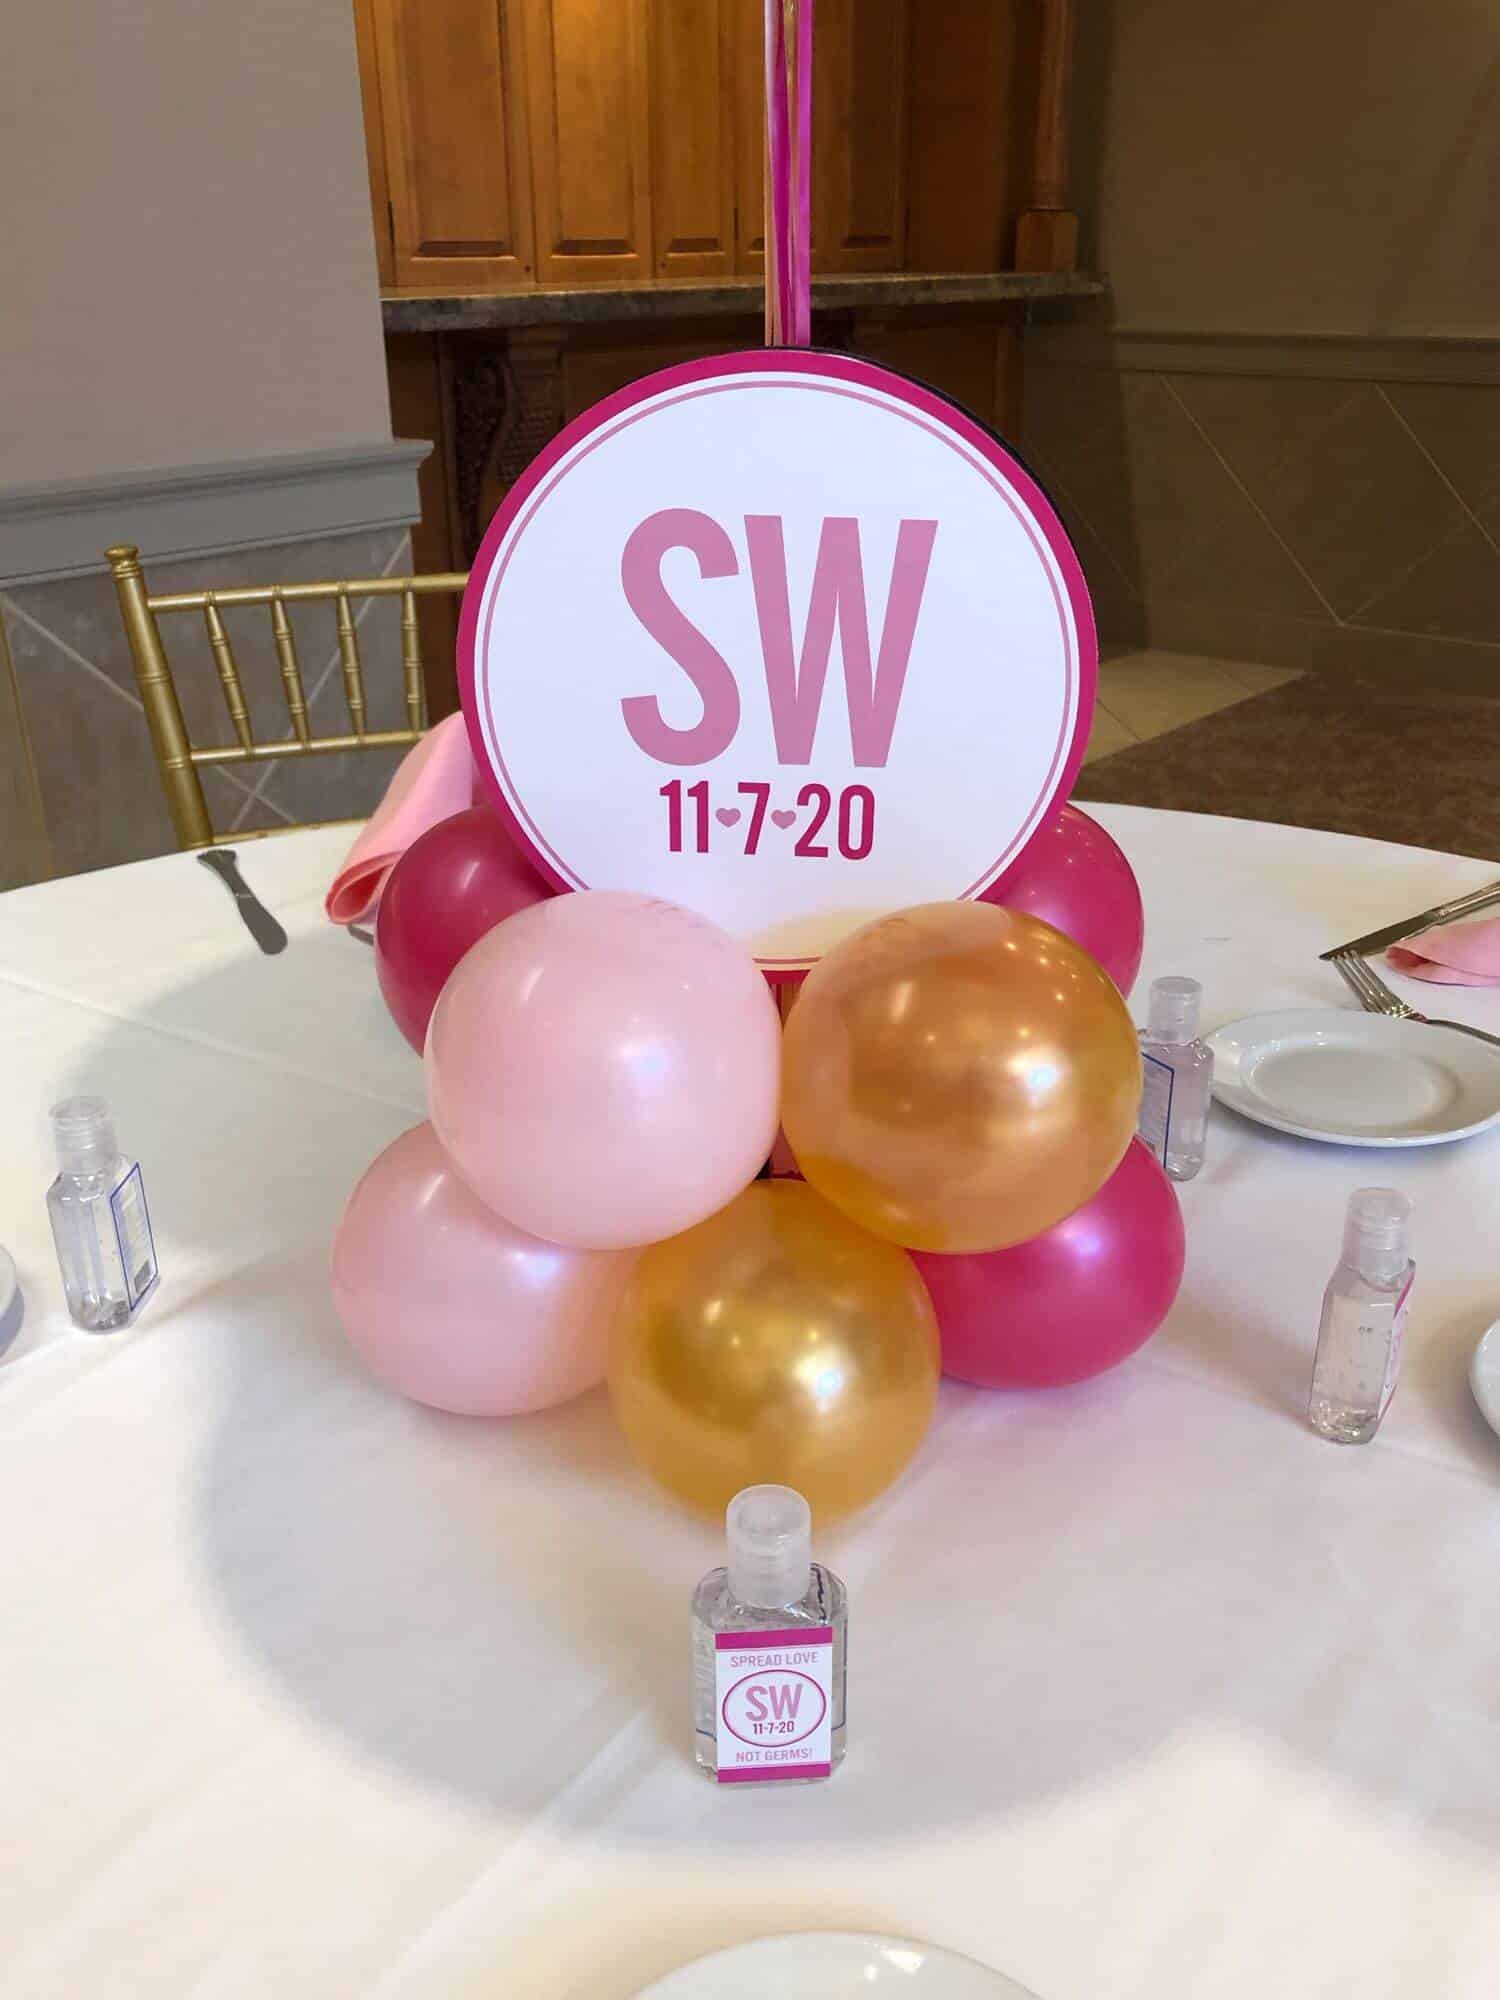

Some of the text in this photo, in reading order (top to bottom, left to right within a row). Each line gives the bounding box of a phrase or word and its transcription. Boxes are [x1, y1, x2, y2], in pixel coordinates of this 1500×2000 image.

[620, 508, 938, 767] SW
[730, 1651, 819, 1668] SPREAD LOVE
[745, 1684, 803, 1722] SW
[735, 1747, 813, 1763] NOT GERMS!
